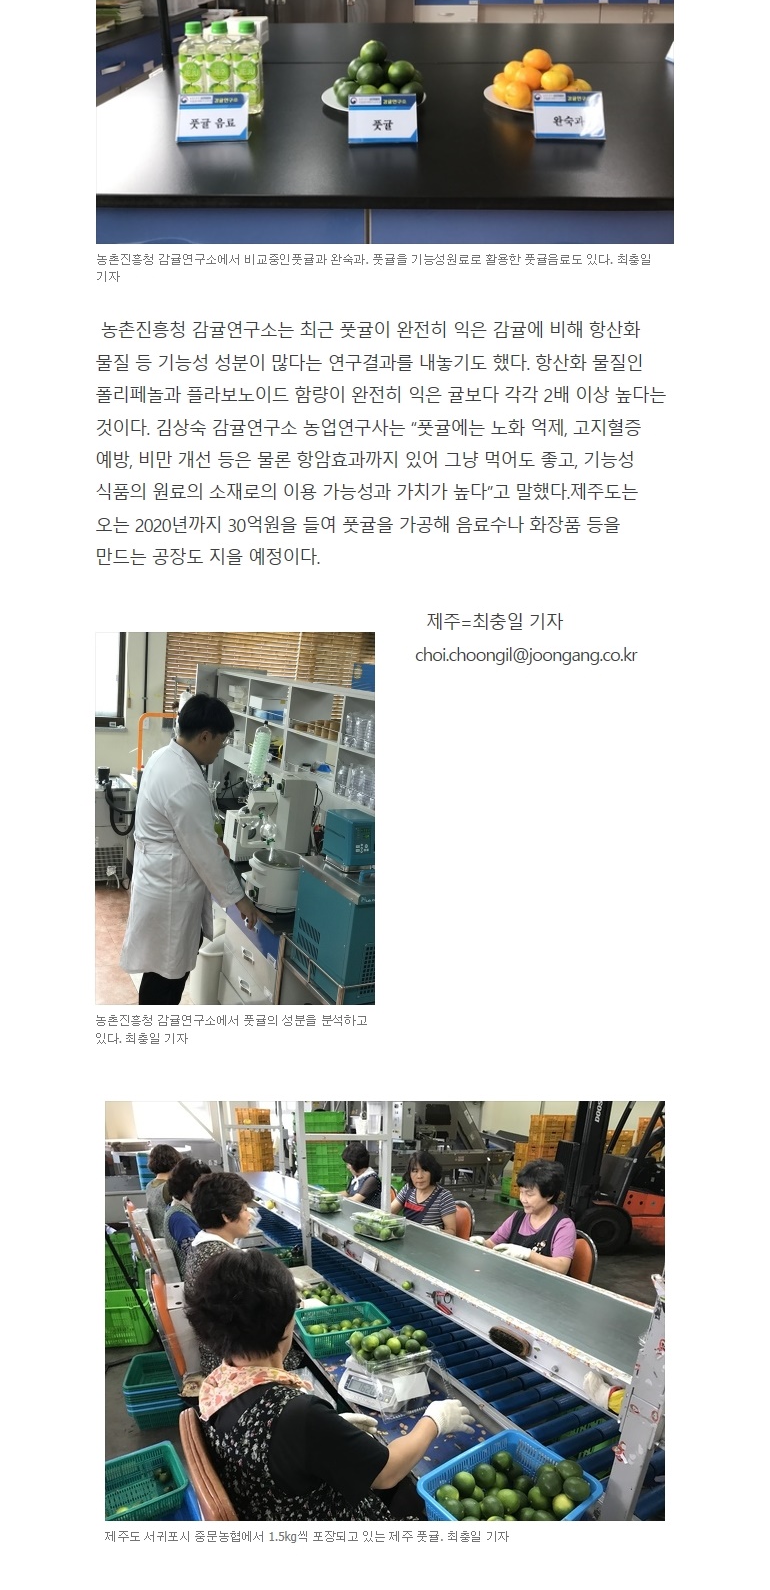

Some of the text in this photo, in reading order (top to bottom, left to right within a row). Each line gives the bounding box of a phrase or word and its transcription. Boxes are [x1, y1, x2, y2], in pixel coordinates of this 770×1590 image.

[189, 118, 236, 130] 풋귤 음료
[372, 118, 394, 131] 풋귤
[553, 115, 584, 127] 완숙과
[96, 547, 321, 566] 만드는 공장도 지을 예정이다.
[426, 612, 564, 631] 제주=최충일 기자
[415, 646, 639, 666] choi.choongil@joongang.co.kr
